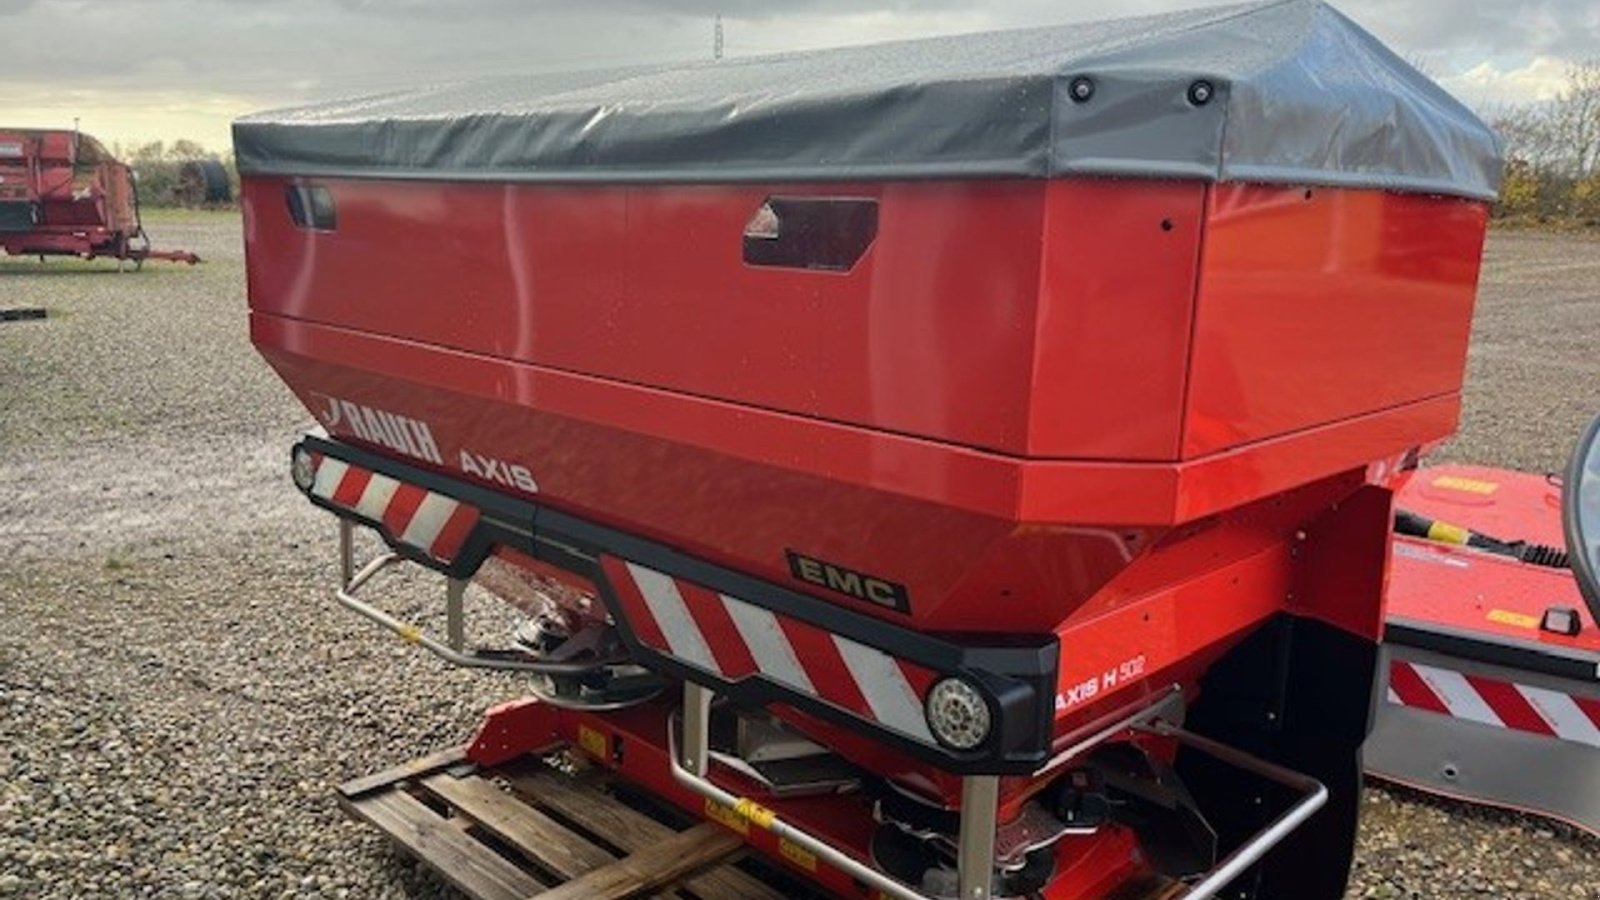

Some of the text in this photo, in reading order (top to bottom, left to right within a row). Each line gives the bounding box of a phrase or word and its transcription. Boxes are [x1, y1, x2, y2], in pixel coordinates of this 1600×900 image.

[341, 400, 538, 493] RAUCH AXIS
[798, 557, 896, 607] EMC
[1055, 677, 1098, 711] AXIS
[1103, 667, 1118, 689] H
